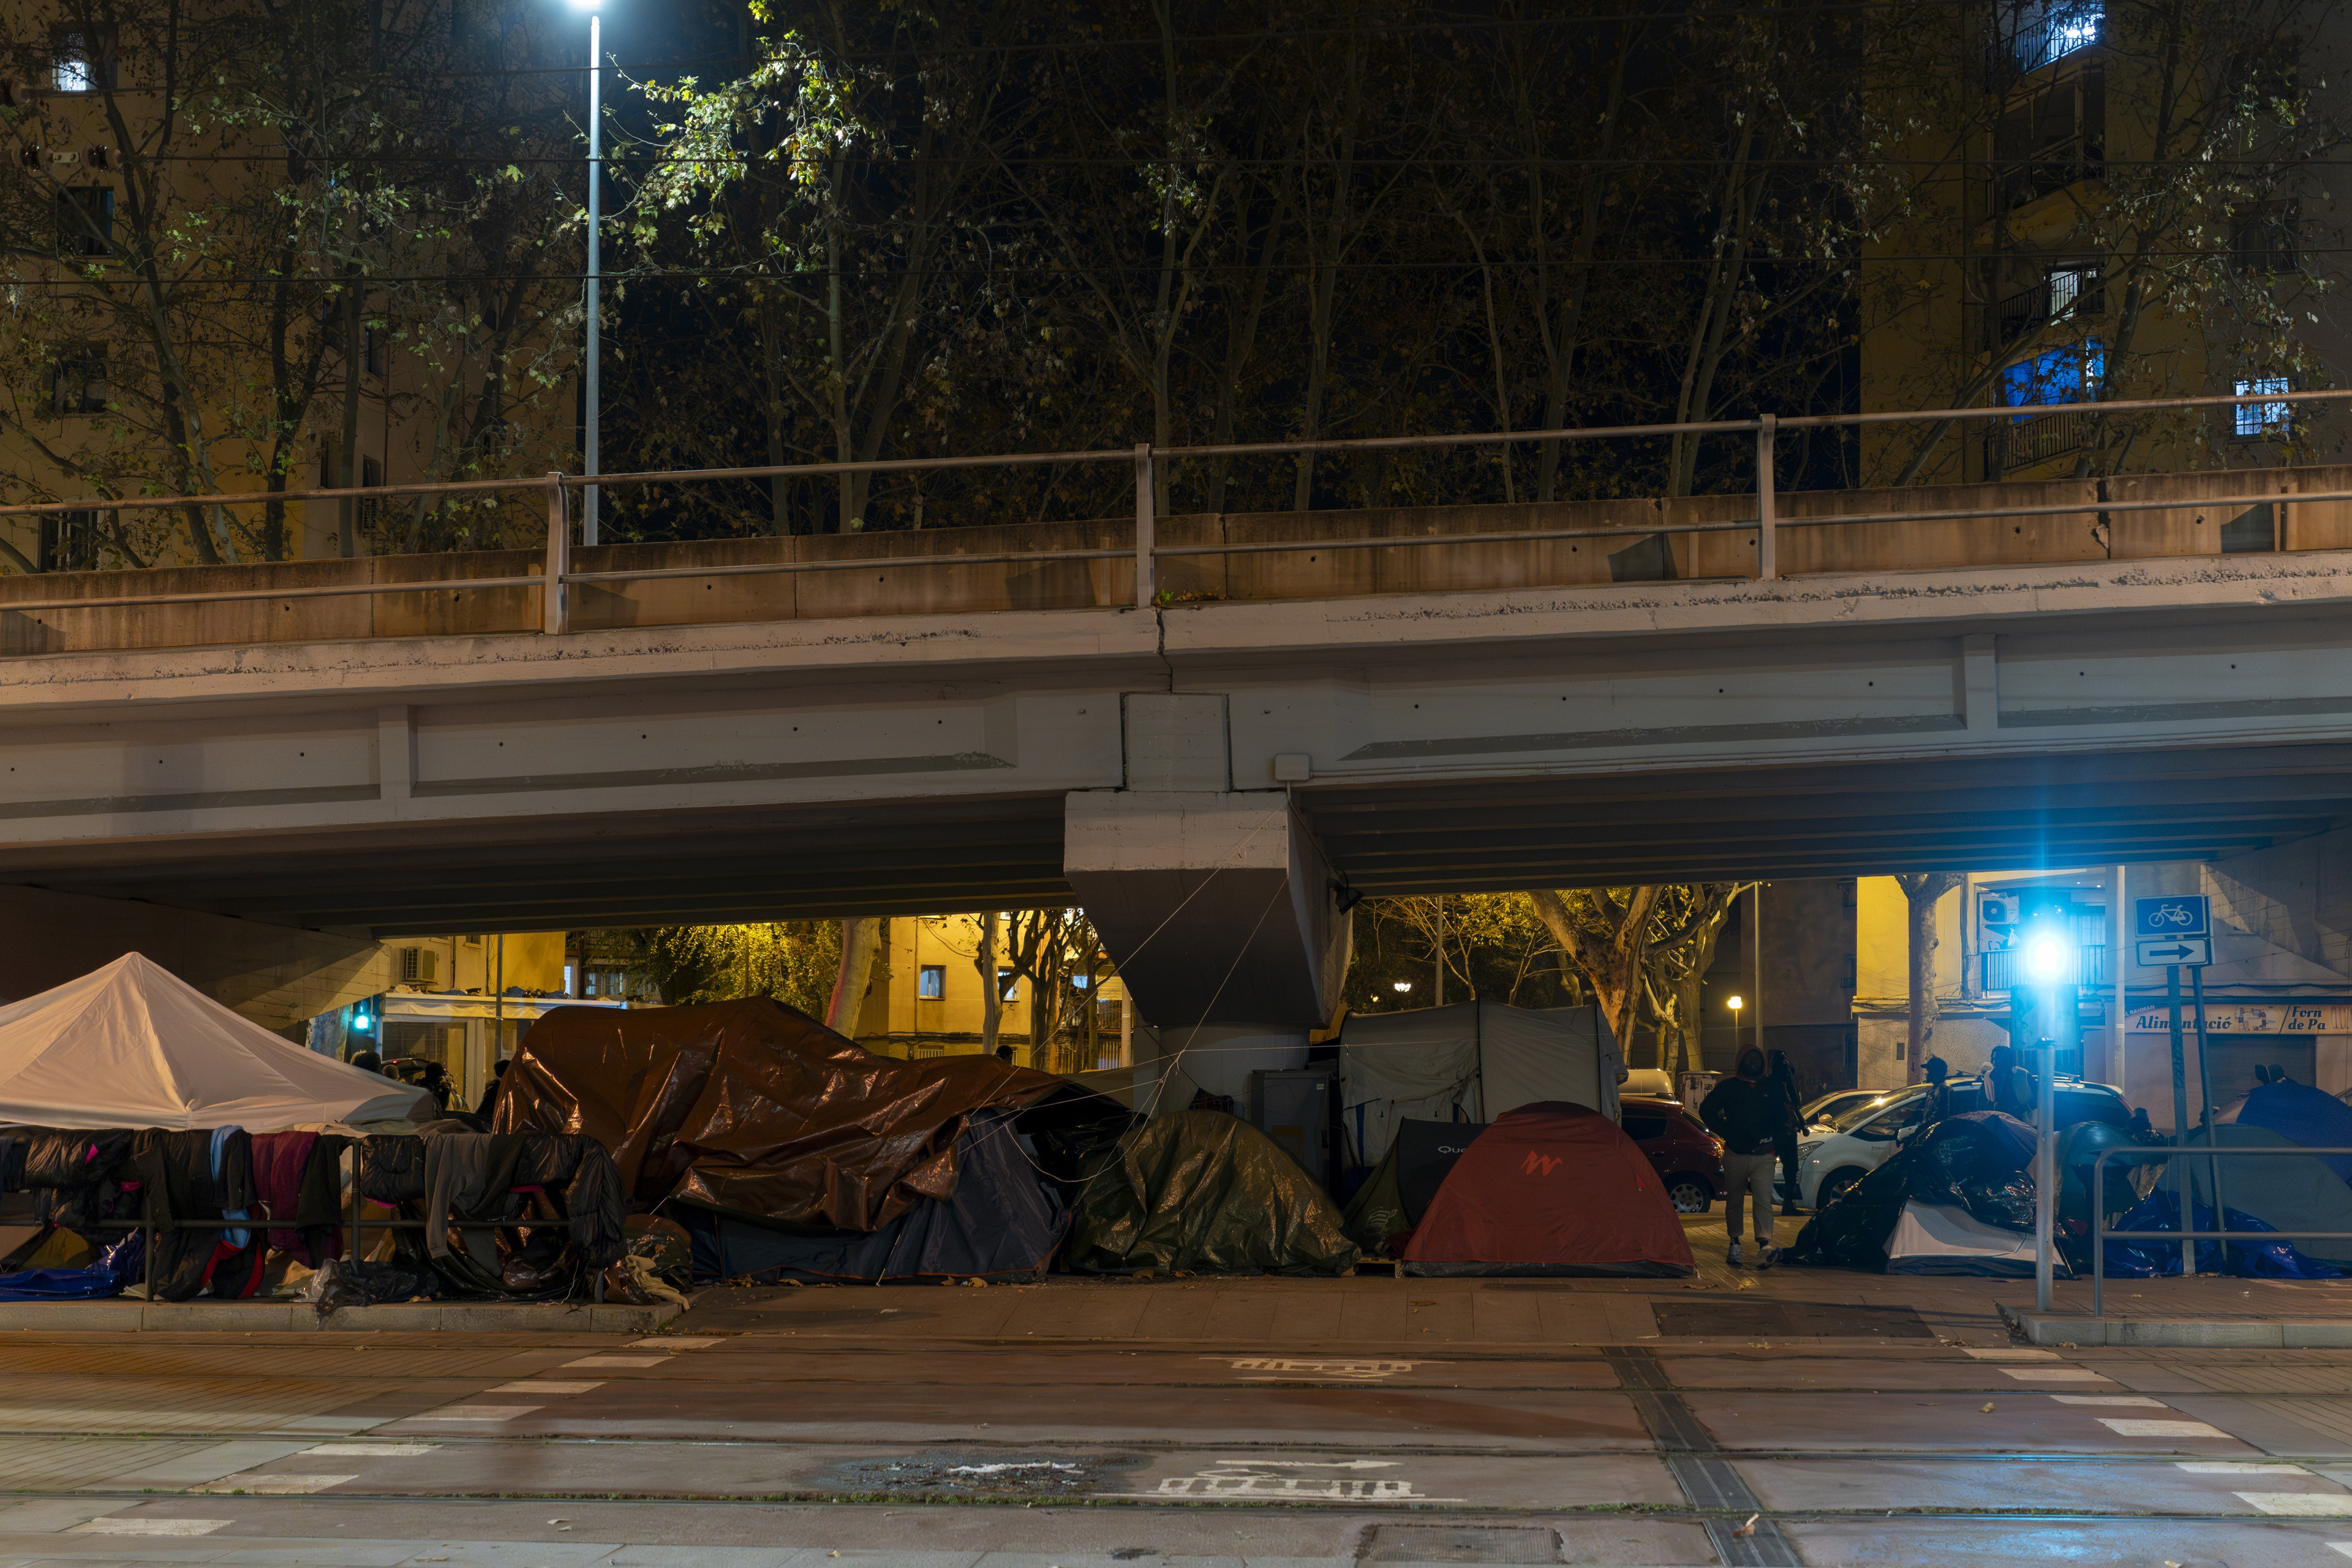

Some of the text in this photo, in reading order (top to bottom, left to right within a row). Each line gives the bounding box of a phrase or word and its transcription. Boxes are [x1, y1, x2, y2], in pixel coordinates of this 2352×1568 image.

[2130, 1005, 2155, 1014] RAHMAN
[2292, 1006, 2321, 1017] Forn
[2136, 1016, 2232, 1029] Alimntció
[2288, 1018, 2326, 1030] de Pa
